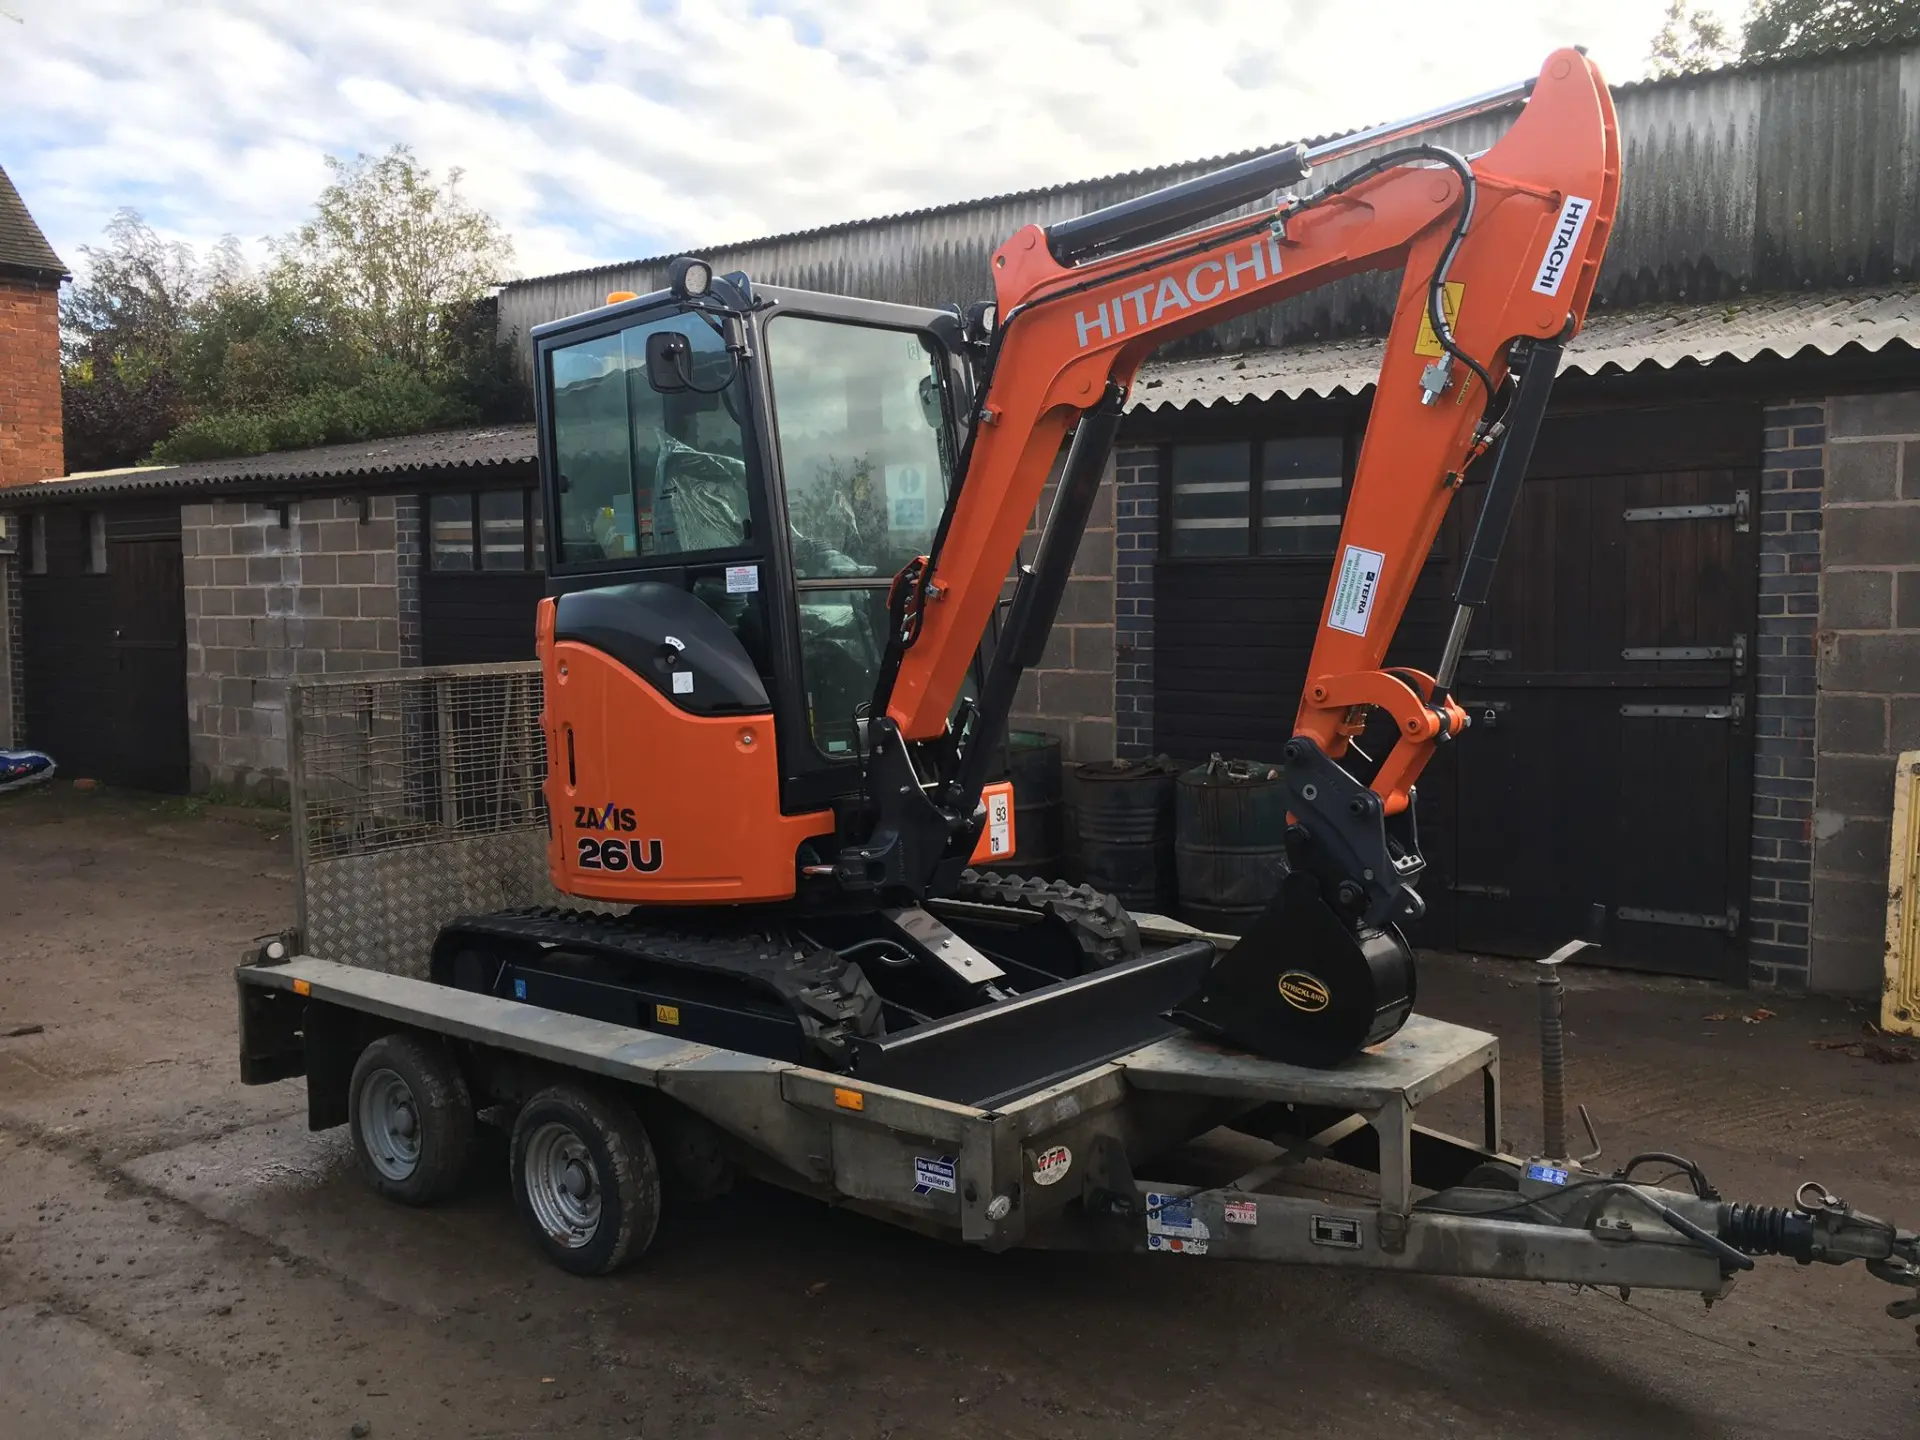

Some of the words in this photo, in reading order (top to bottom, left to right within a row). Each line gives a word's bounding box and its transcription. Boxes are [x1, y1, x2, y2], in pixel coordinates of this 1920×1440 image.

[1540, 203, 1584, 289] HITACHI
[1075, 237, 1283, 348] HITACHI
[1343, 566, 1351, 583] SAFETY
[1334, 592, 1344, 615] REQUIRED
[1357, 582, 1372, 614] TEFRA
[574, 803, 637, 832] ZAXIS
[996, 806, 1007, 821] 93
[578, 837, 663, 873] 26U
[991, 837, 1000, 852] 78
[1281, 981, 1325, 1003] STRICKLAND
[920, 1172, 951, 1188] Trailers
[927, 1162, 953, 1177] Williams
